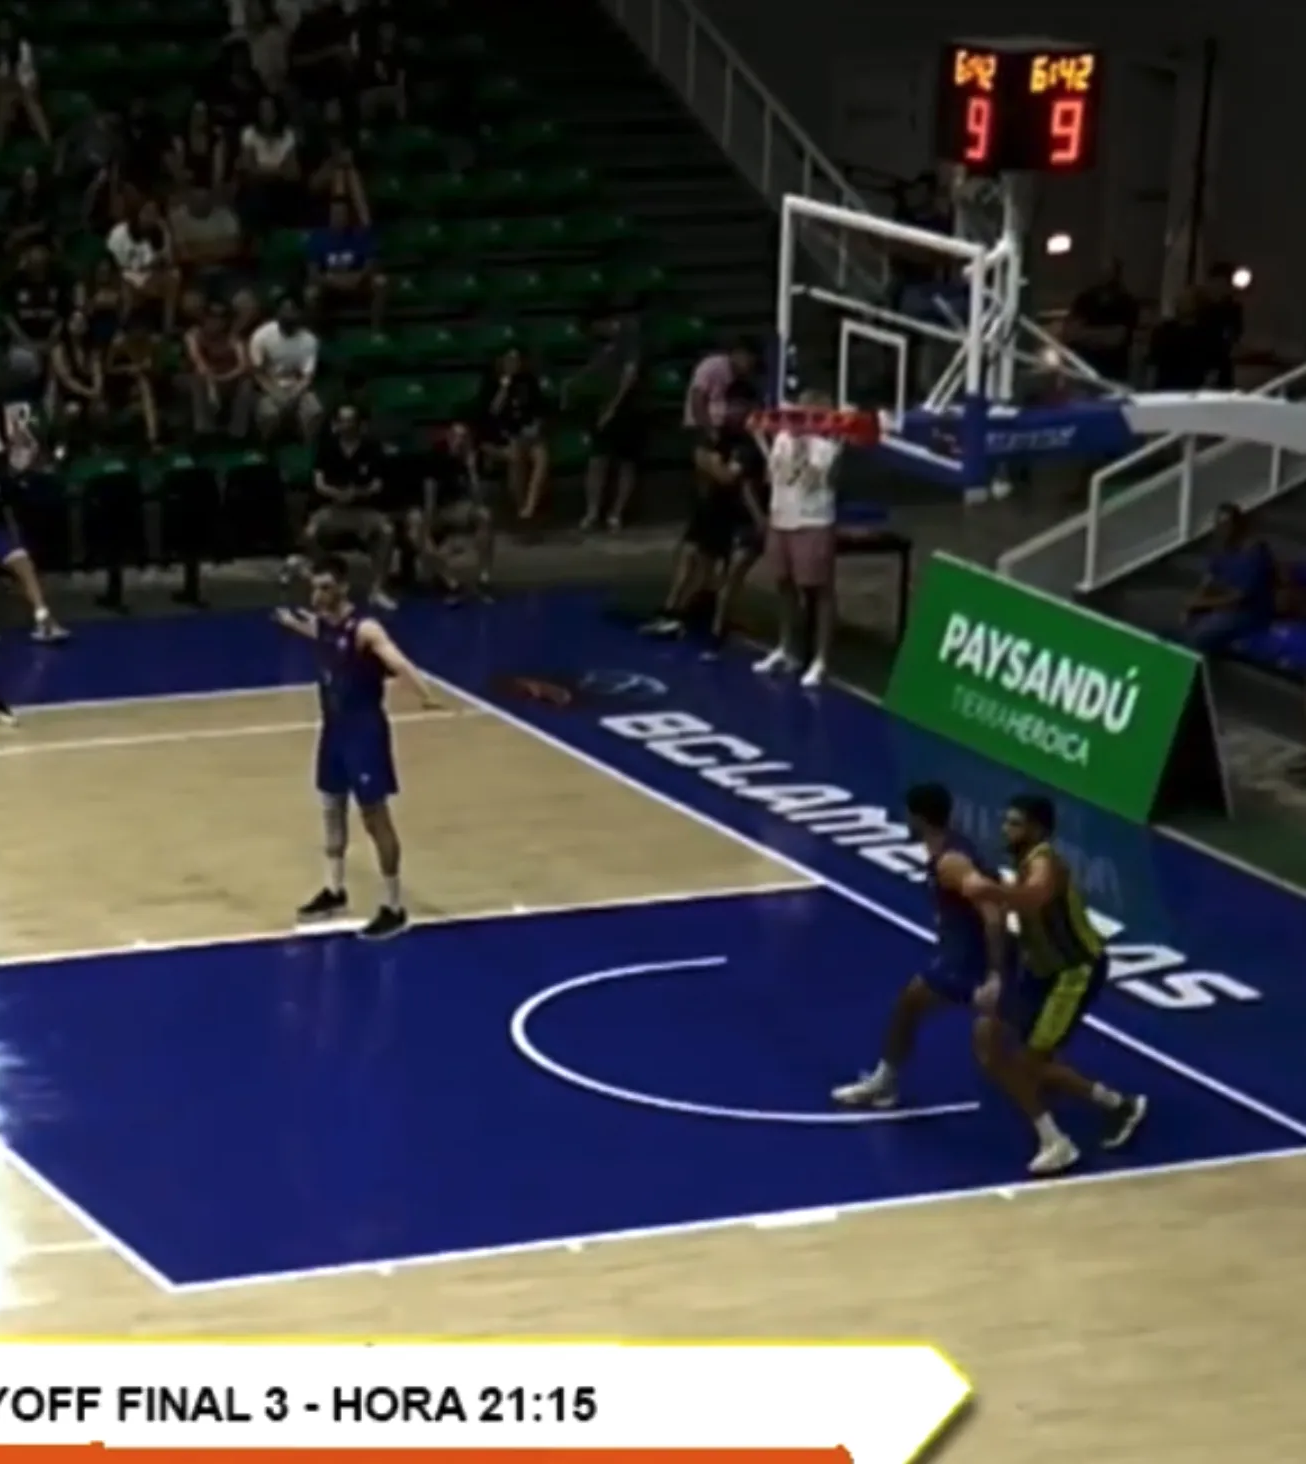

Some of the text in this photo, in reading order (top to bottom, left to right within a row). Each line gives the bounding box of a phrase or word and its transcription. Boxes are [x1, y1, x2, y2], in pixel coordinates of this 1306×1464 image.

[965, 97, 991, 161] 9
[1050, 98, 1085, 164] 9
[938, 611, 1140, 734] PAYSANDÚ
